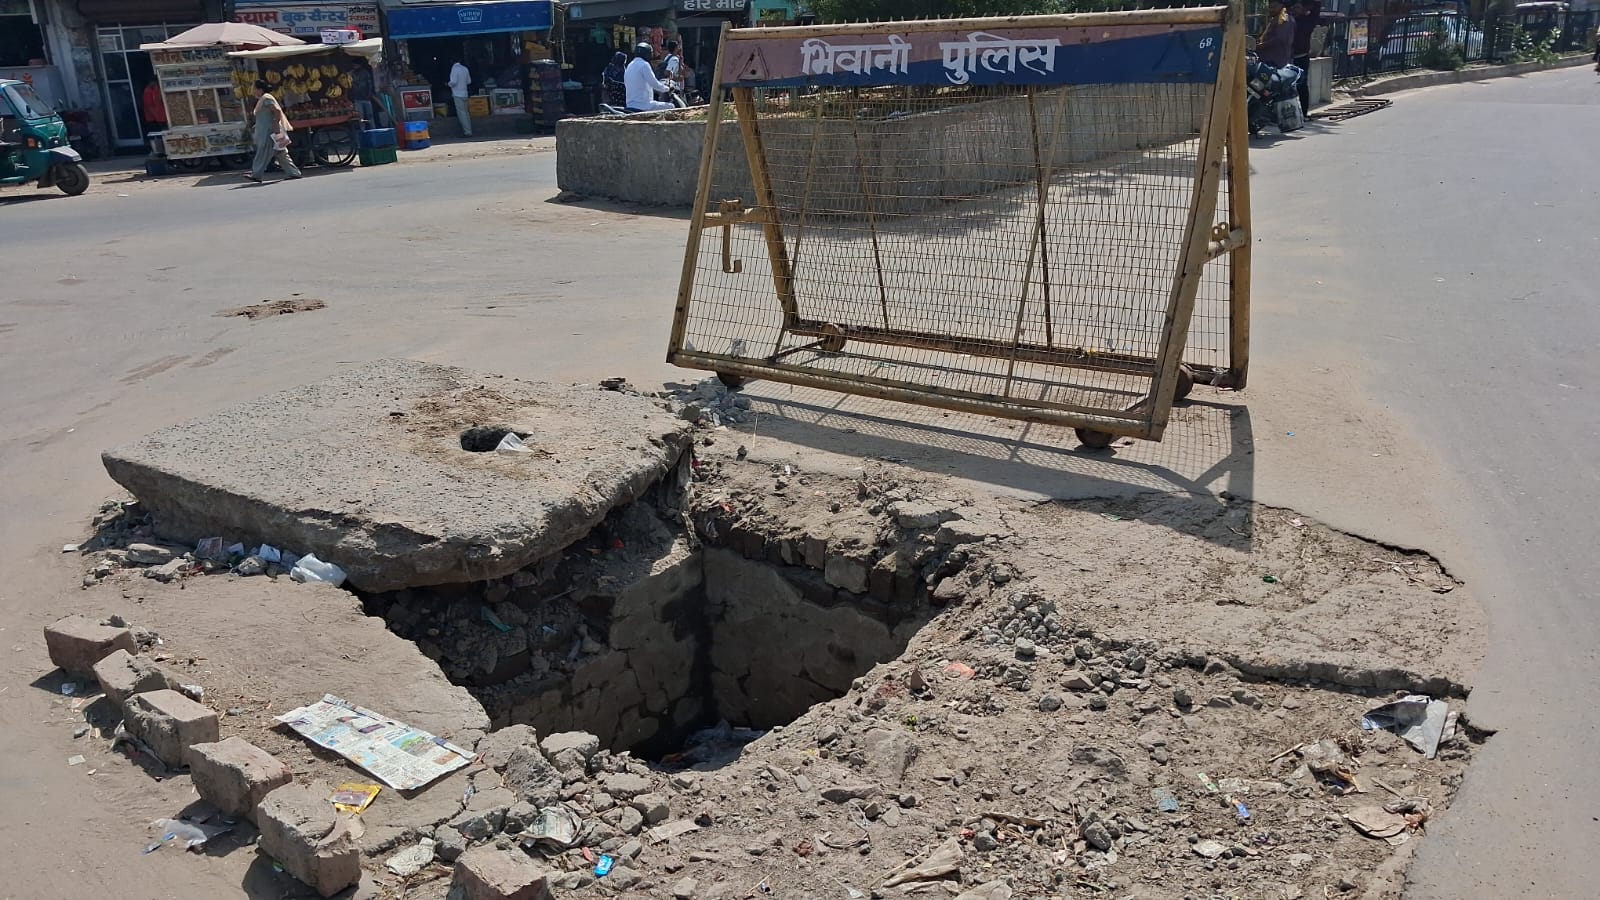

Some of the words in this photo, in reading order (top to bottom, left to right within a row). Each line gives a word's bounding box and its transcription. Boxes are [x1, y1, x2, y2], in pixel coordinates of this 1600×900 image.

[282, 11, 306, 26] बुक
[1199, 37, 1213, 49] 68
[800, 34, 912, 76] भिवानी
[939, 31, 1064, 85] पुलिस
